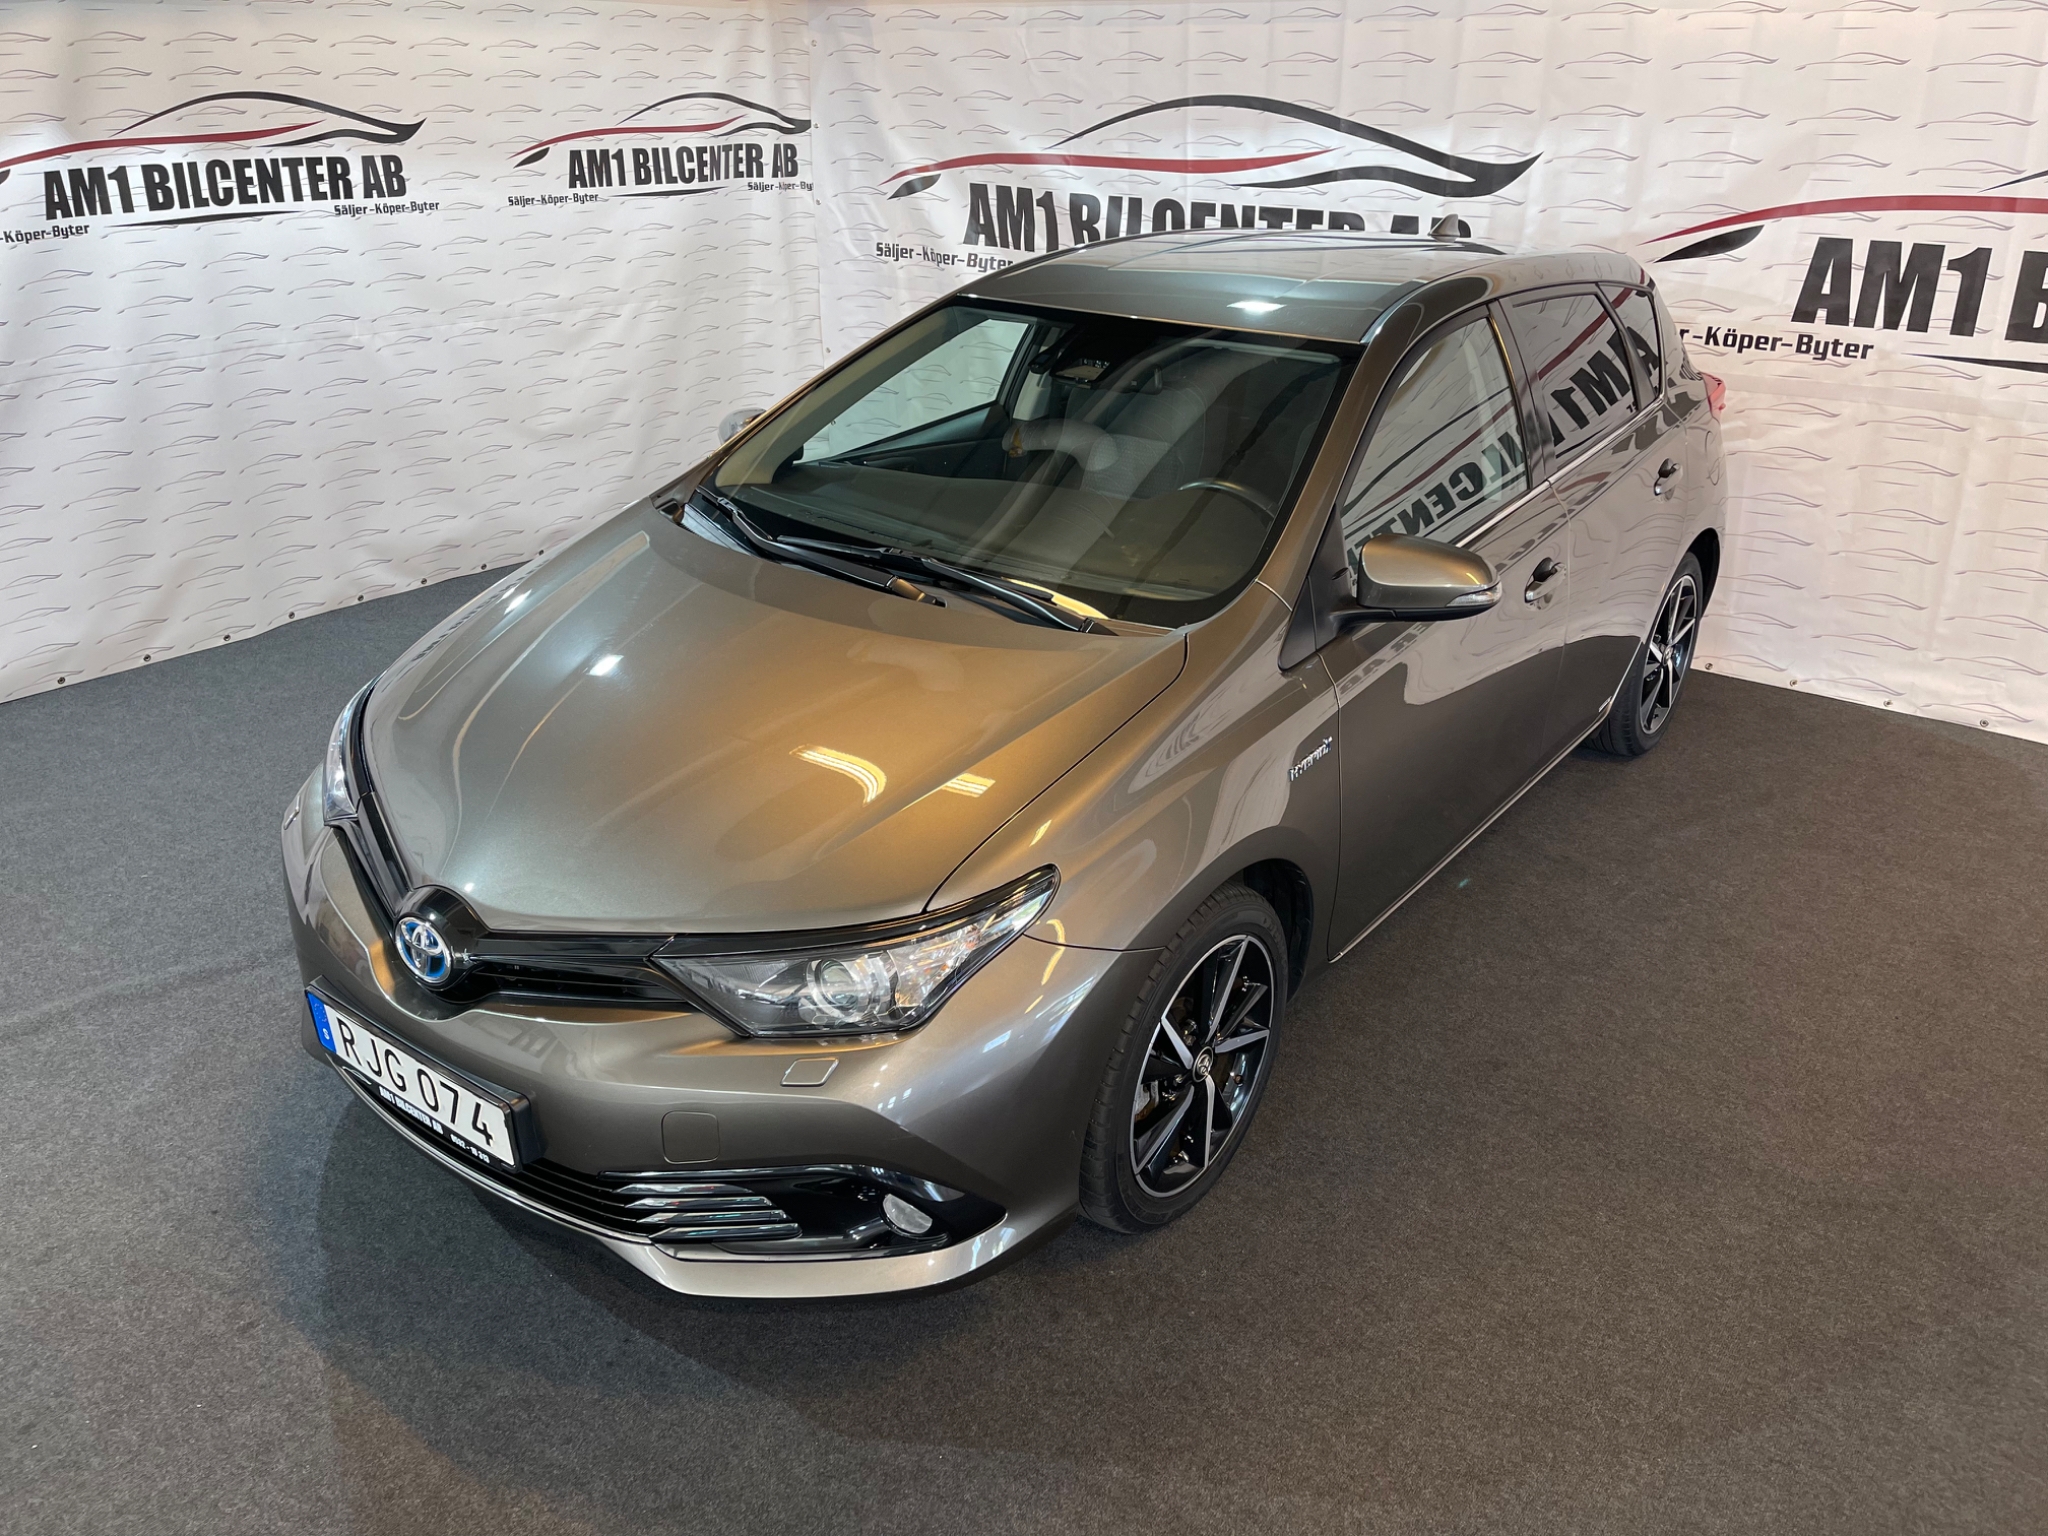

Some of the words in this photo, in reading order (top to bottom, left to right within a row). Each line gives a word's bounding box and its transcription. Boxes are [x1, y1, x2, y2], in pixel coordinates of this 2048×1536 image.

[44, 165, 135, 220] AM1
[141, 156, 354, 212] BILCENTER
[361, 154, 407, 199] AB
[568, 149, 627, 188] AM1
[632, 143, 764, 186] BILCENTER
[771, 143, 799, 179] AB
[963, 183, 1059, 253] AM1
[1791, 236, 1992, 337] AM1
[336, 1016, 407, 1092] RJG
[416, 1068, 494, 1147] 074
